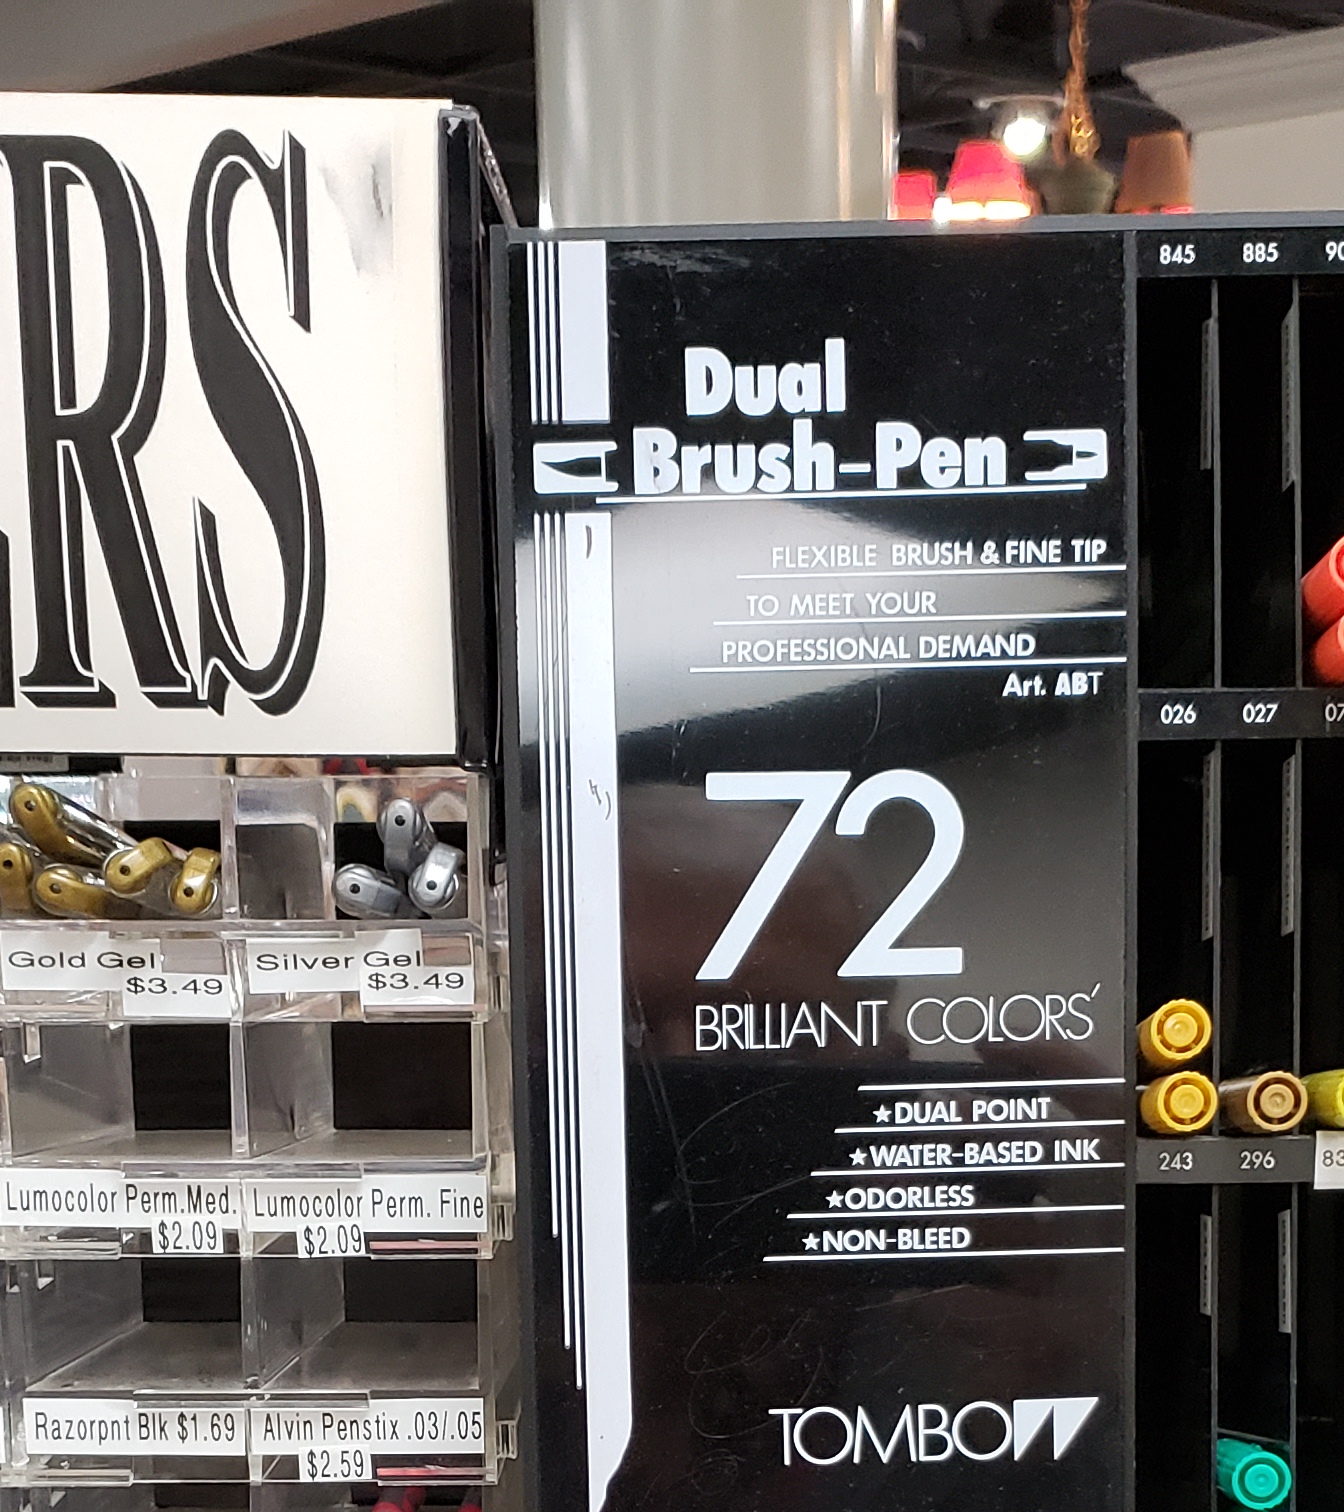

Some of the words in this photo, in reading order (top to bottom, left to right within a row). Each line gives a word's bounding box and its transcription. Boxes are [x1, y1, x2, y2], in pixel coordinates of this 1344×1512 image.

[1160, 245, 1196, 264] 845
[684, 337, 846, 417] Dual
[632, 418, 1008, 495] Brush-Pen
[771, 544, 878, 568] FLEXIBLE
[891, 543, 973, 566] BRUSH
[979, 542, 1000, 564] &
[1006, 540, 1062, 564] FINE
[1071, 539, 1107, 562] TIP
[746, 595, 779, 617] TO
[789, 593, 854, 616] MEET
[865, 591, 938, 615] YOUR
[722, 636, 911, 663] PROFESSIONAL
[918, 634, 1036, 659] DEMAND
[1002, 673, 1046, 696] Art.
[1055, 672, 1103, 695] ABT
[695, 769, 964, 981] 72
[256, 952, 353, 971] Silver
[364, 950, 422, 968] Gel
[367, 971, 465, 992] $3.49
[695, 1000, 888, 1051] BRILLIANT
[894, 1100, 962, 1124] DUAL
[972, 1097, 1051, 1120] POINT
[870, 1142, 1042, 1168] WATER-BASED
[1053, 1140, 1100, 1161] INK
[844, 1185, 974, 1210] ODORLESS
[822, 1227, 971, 1252] NON-BLEED
[264, 1412, 312, 1441] Alvin
[318, 1411, 398, 1442] Penstix
[307, 1450, 365, 1480] $2.59
